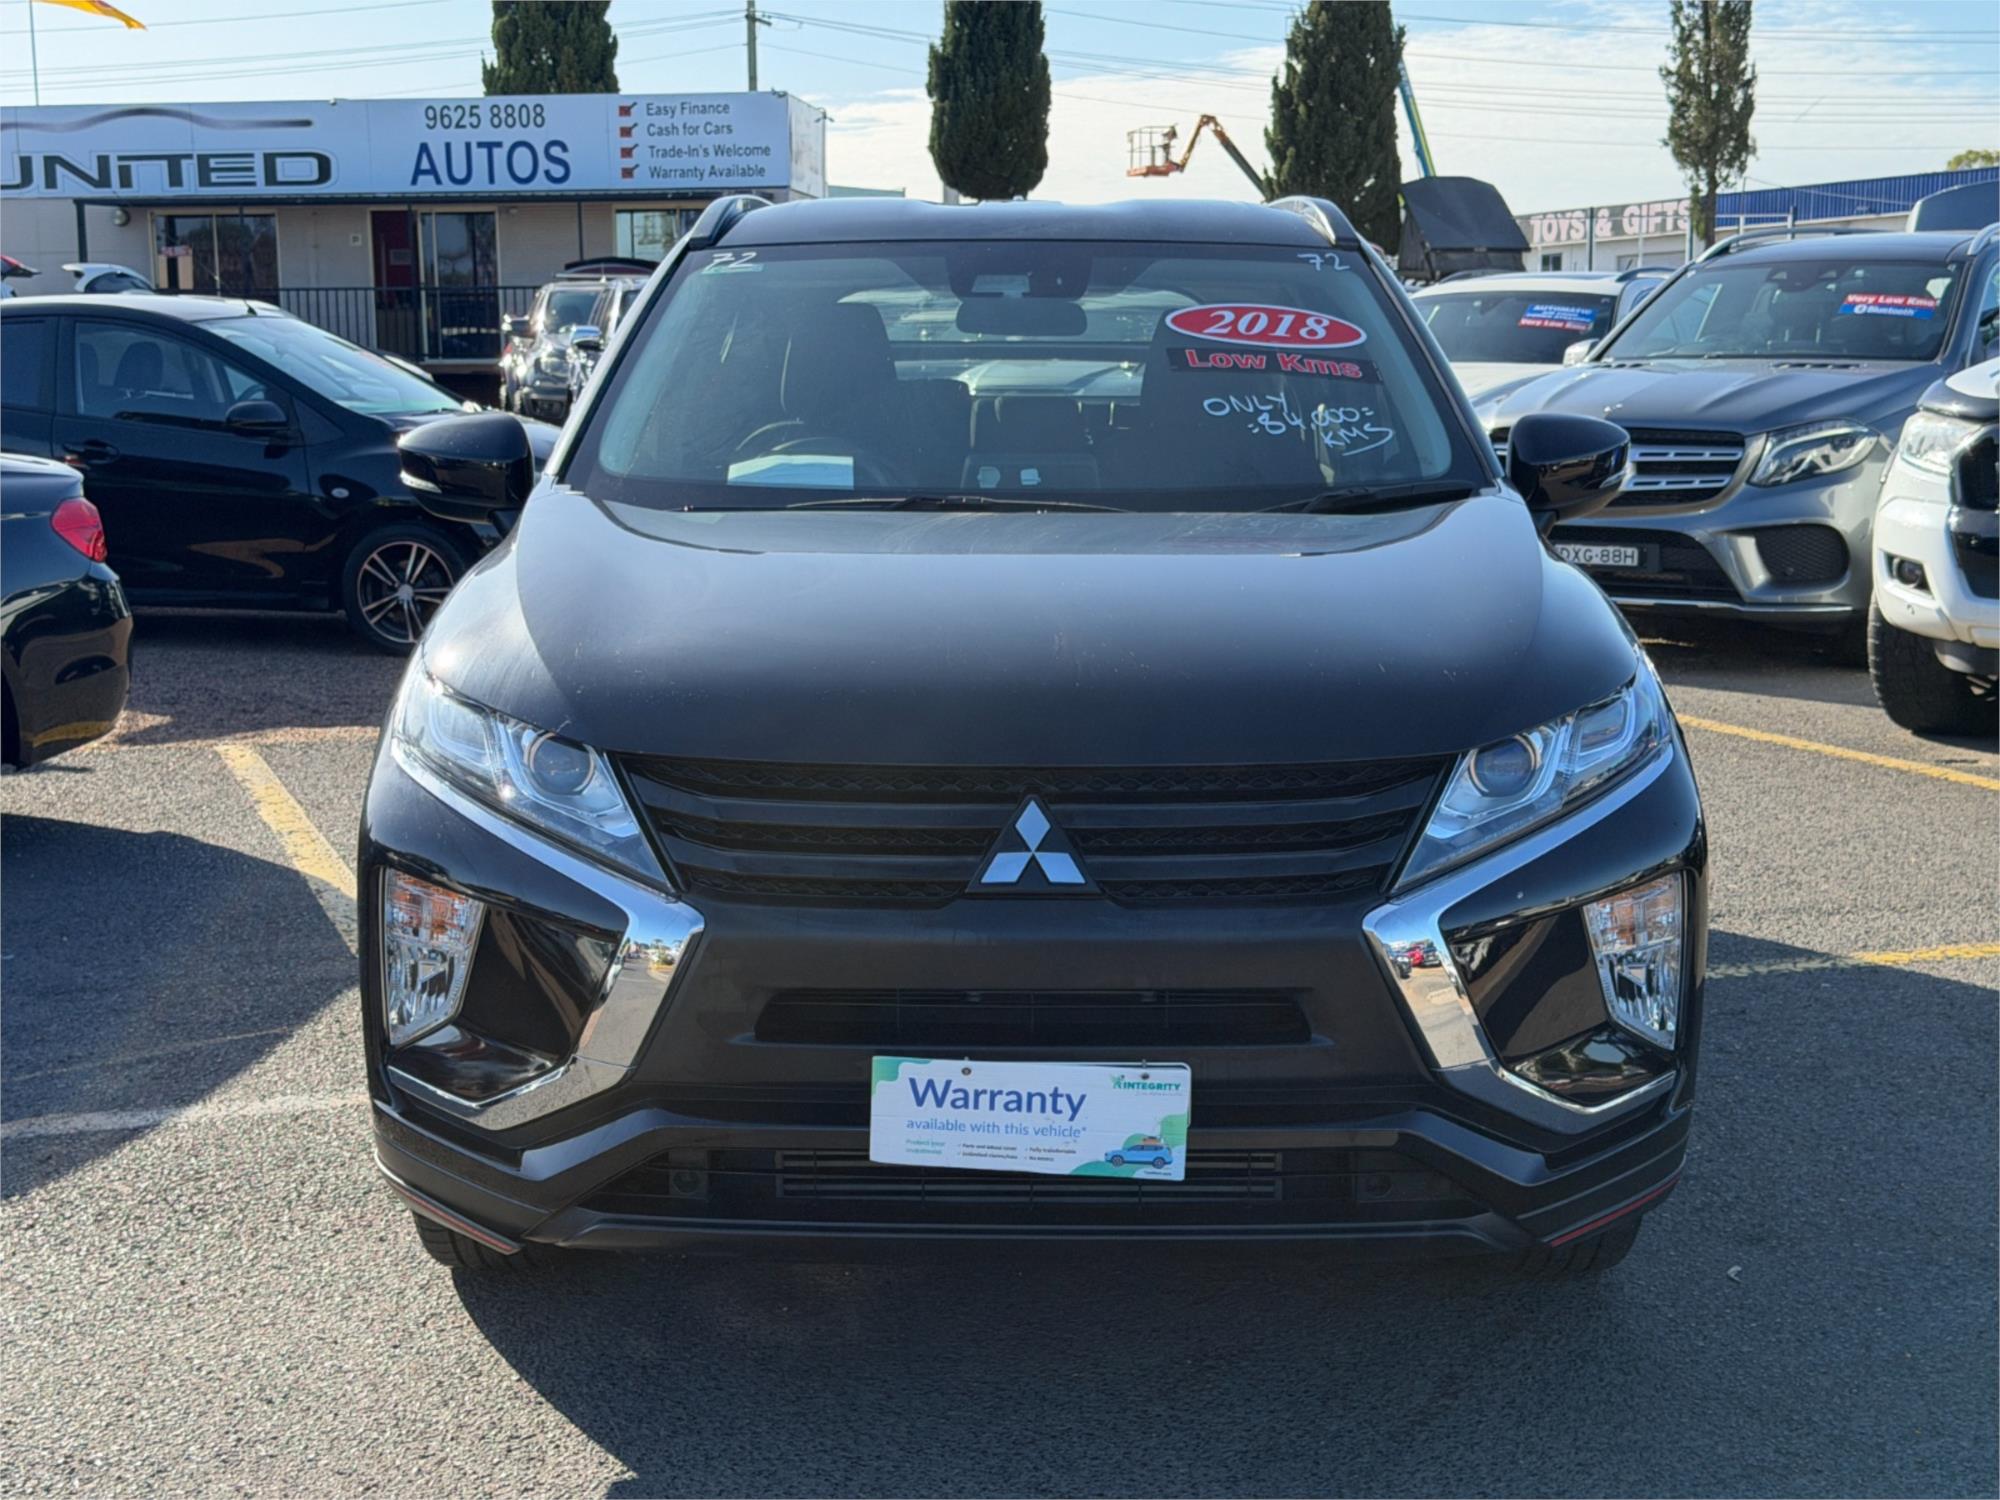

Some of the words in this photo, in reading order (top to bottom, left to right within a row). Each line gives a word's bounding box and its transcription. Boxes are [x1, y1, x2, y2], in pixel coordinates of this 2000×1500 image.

[424, 104, 482, 130] 9625
[489, 103, 546, 129] 8808
[646, 102, 677, 118] Easy
[681, 101, 730, 115] Finance
[647, 122, 680, 137] Cash
[682, 122, 702, 136] for
[704, 122, 734, 135] Cars
[648, 144, 710, 159] Trade-In's
[713, 143, 771, 157] Welcome
[410, 140, 571, 187] AUTOS
[649, 165, 705, 181] Warranty
[708, 164, 766, 178] Available
[1530, 209, 1586, 243] TOYS
[1595, 208, 1613, 237] &
[1622, 200, 1691, 235] GIFTS
[1298, 253, 1350, 271] 72
[1203, 310, 1332, 340] 2018
[1185, 349, 1266, 369] Low
[1277, 352, 1362, 379] Kms
[1203, 392, 1288, 416] ONLY
[1321, 423, 1395, 456] KMS
[1123, 1081, 1181, 1091] INTEGRITY
[908, 1077, 1087, 1122] Warranty
[906, 1117, 966, 1133] available
[970, 1119, 1001, 1135] with
[1004, 1121, 1030, 1137] this
